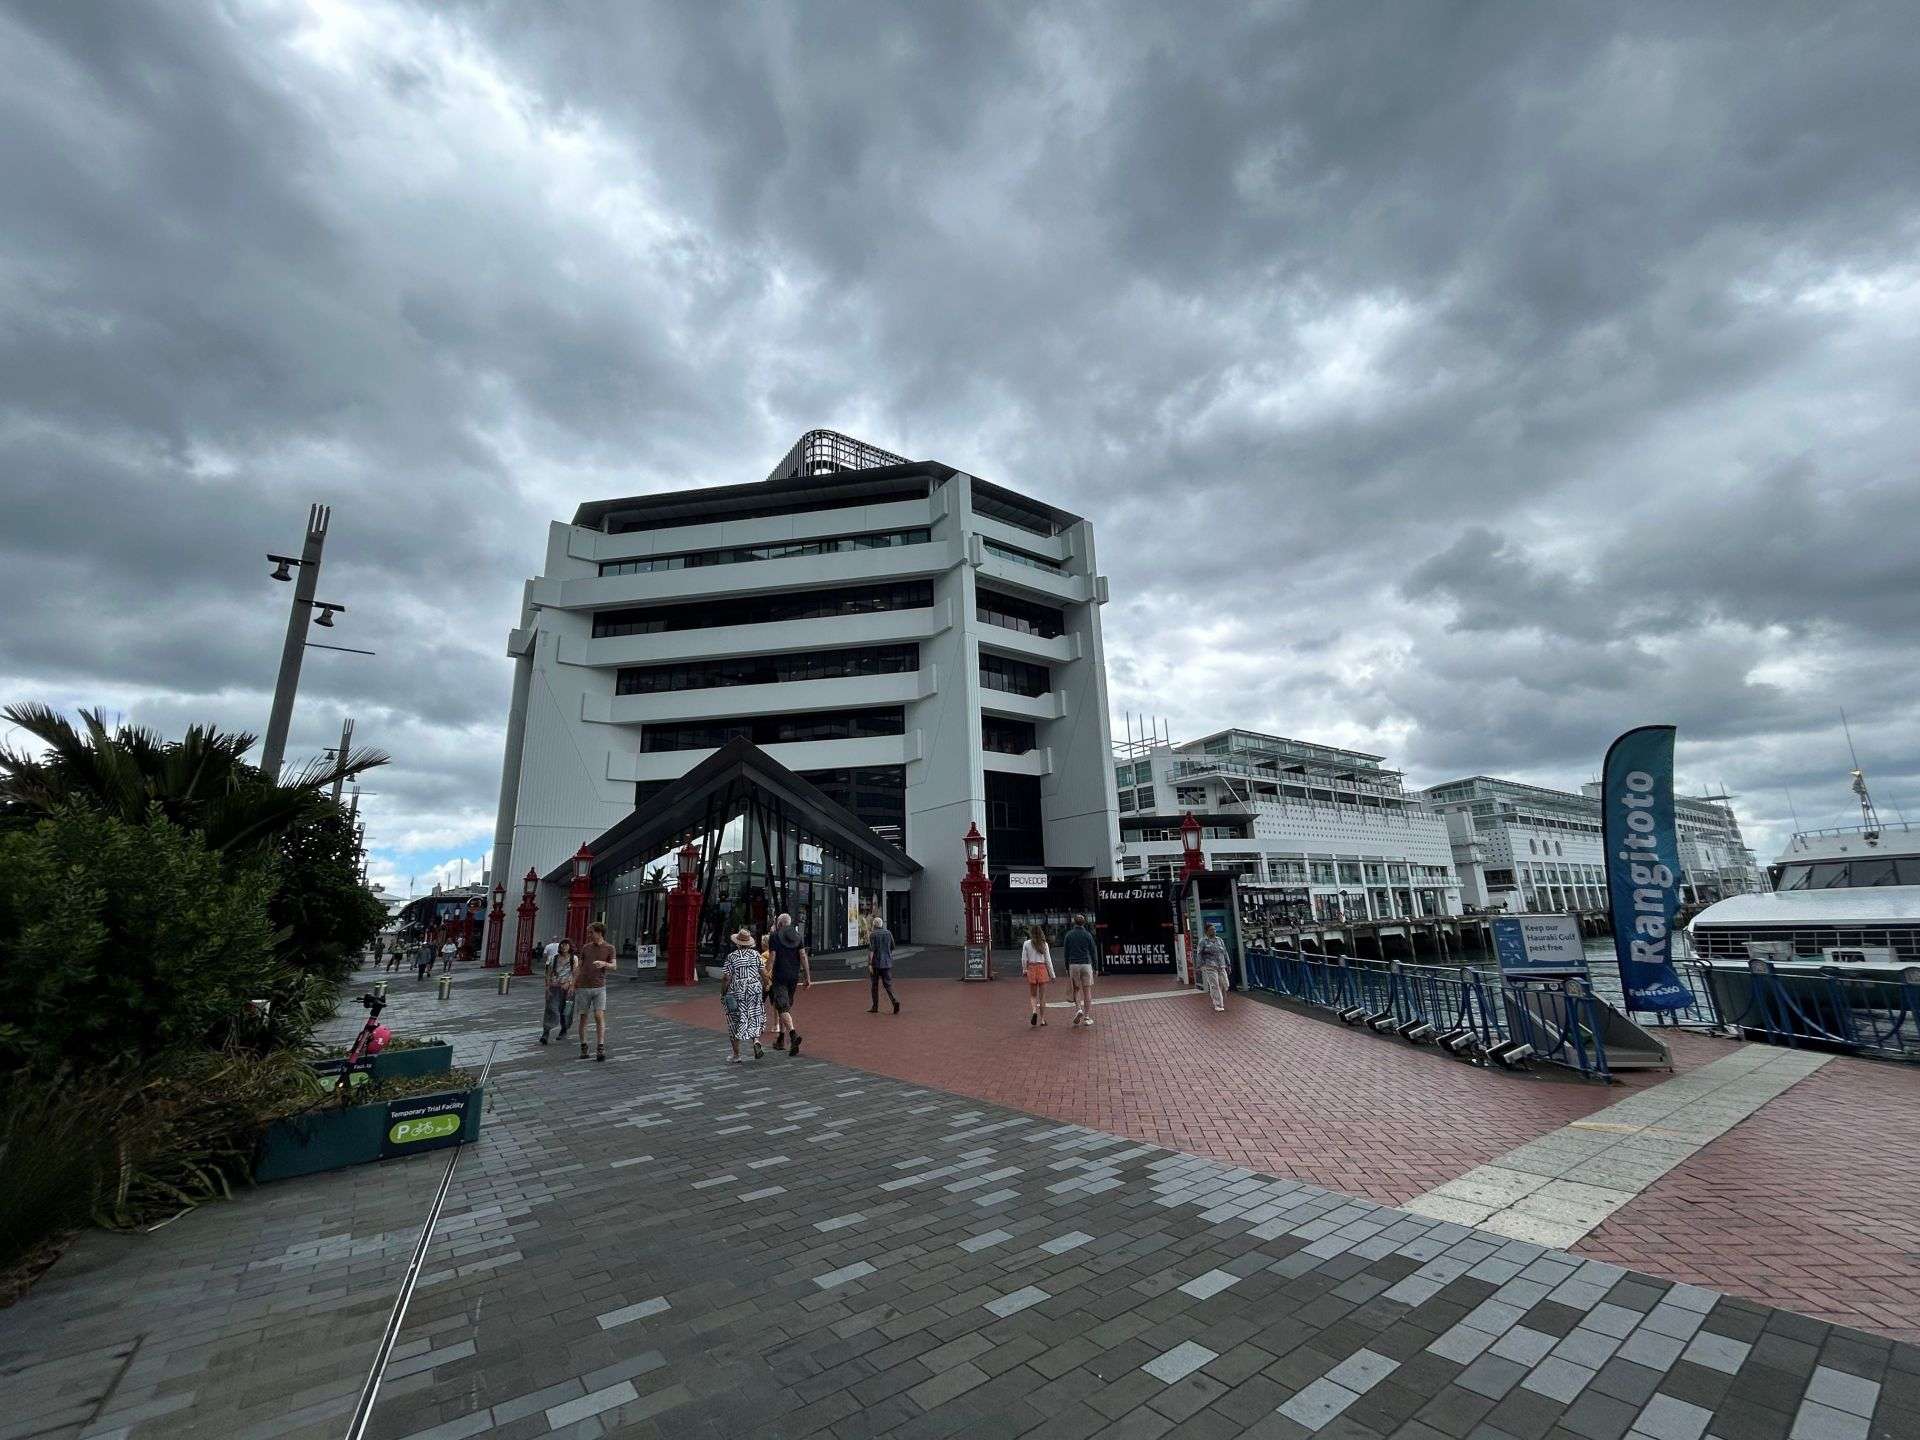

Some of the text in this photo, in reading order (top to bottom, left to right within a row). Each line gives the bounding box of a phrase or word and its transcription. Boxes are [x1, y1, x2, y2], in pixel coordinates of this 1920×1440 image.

[1619, 770, 1674, 964] Rangitoto
[1010, 876, 1047, 884] PROVEDOR
[1099, 889, 1164, 900] Island Direct
[1525, 925, 1544, 933] Keep
[1527, 933, 1576, 941] Hauraki Gulf
[1123, 944, 1166, 954] WAIHEKE
[1529, 944, 1546, 952] pest
[1105, 955, 1170, 965] TICKETS HERE
[391, 1102, 465, 1119] Temporary Trial Facility
[397, 1125, 410, 1139] P
